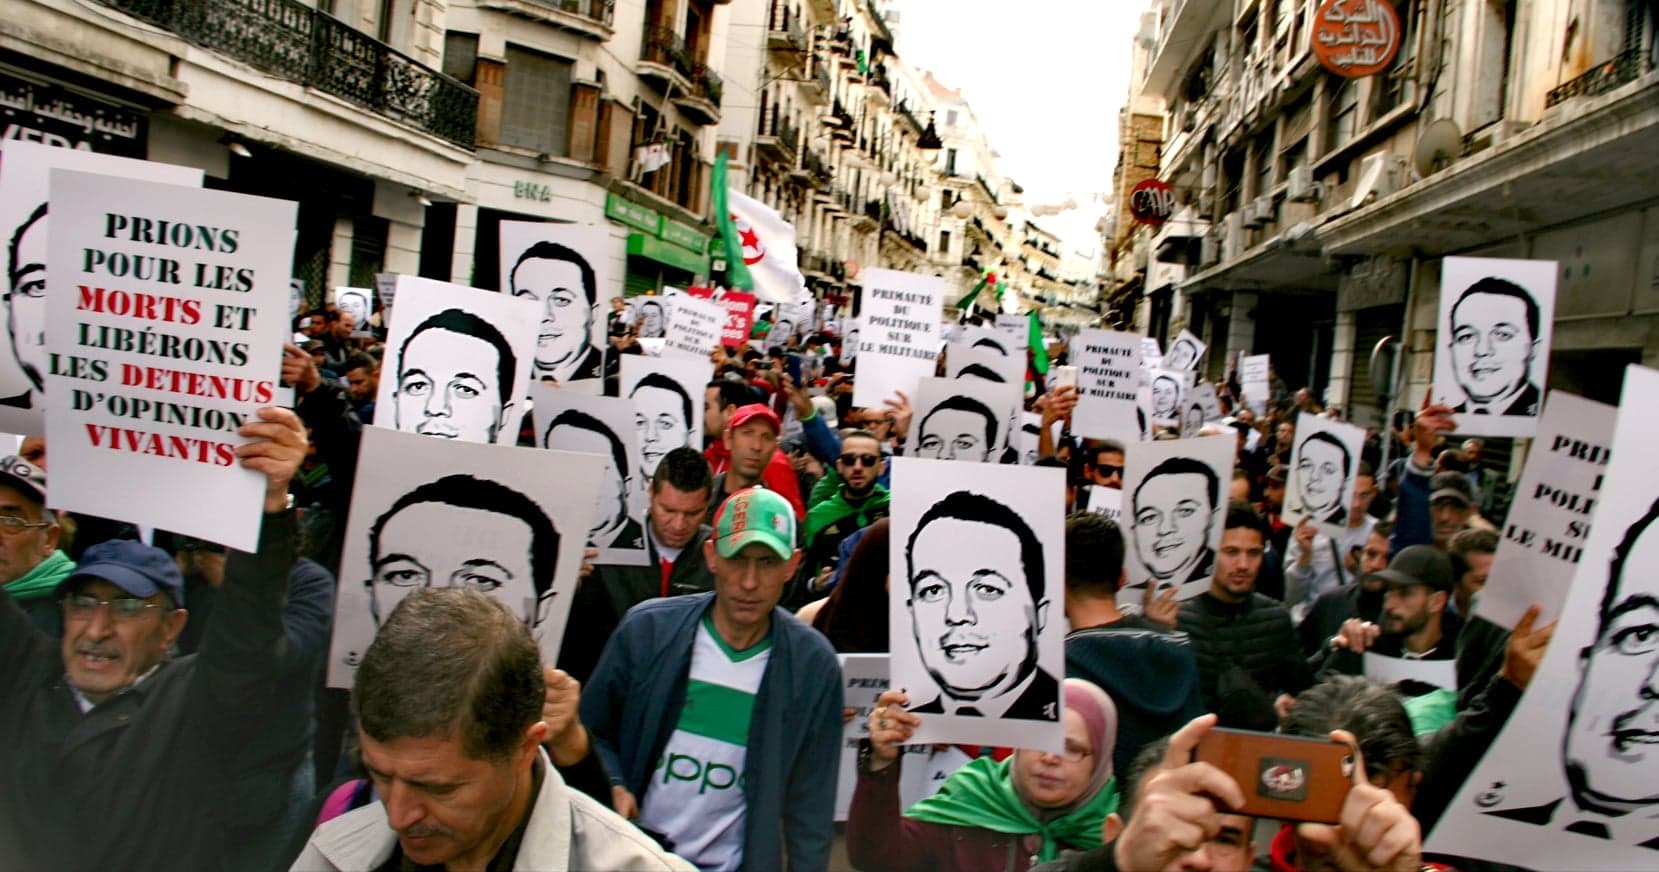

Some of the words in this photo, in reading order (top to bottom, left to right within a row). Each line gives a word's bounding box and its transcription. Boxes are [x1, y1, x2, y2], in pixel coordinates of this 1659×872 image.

[104, 213, 240, 254] PRIONS
[82, 248, 181, 285] POUR
[193, 262, 255, 293] LES
[76, 285, 201, 325] MORTS
[214, 304, 257, 331] ET
[894, 305, 910, 315] DU
[869, 315, 931, 332] POLITIQUE
[77, 322, 249, 367] LIBÉRONS
[888, 332, 912, 343] SUR
[860, 342, 874, 352] LE
[879, 343, 937, 360] MILITAIRE
[1101, 357, 1112, 366] DU
[48, 352, 109, 382] LES
[120, 363, 274, 404] DETENUS
[1083, 366, 1130, 379] POLITIQUE
[1096, 379, 1115, 388] SUR
[1090, 388, 1137, 401] MILITAIRE
[84, 423, 236, 467] VIVANTS
[1534, 483, 1598, 514] POLI
[1506, 524, 1536, 548] LE
